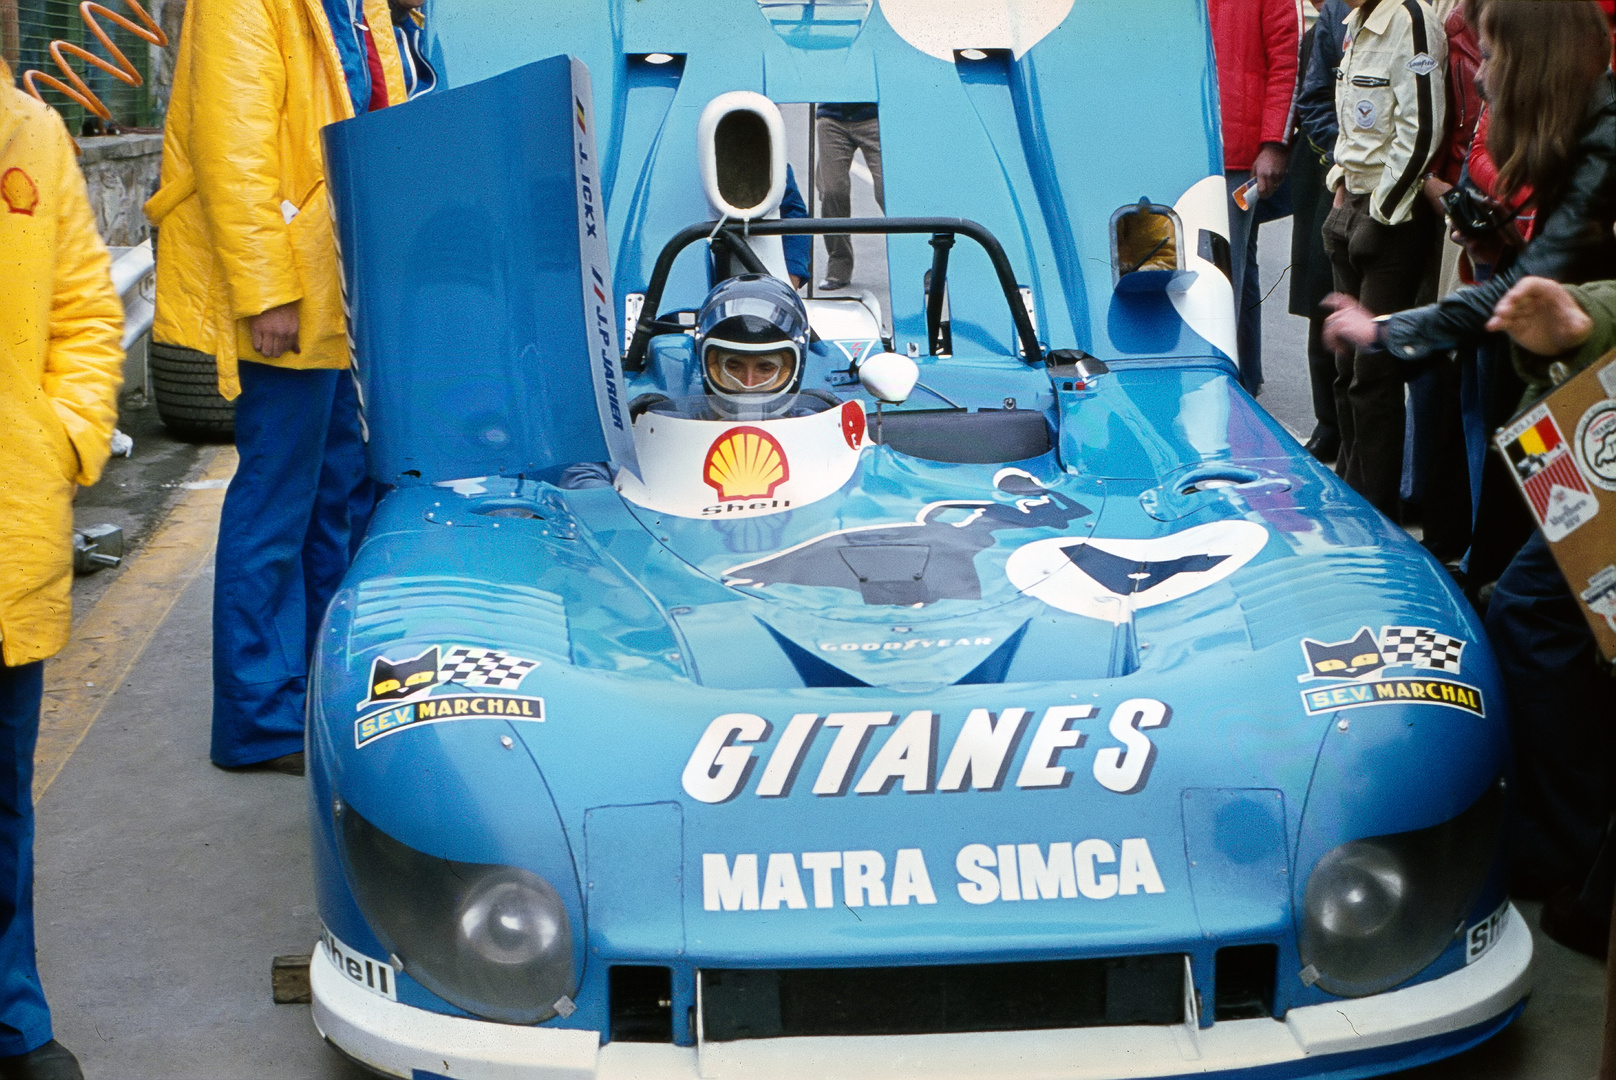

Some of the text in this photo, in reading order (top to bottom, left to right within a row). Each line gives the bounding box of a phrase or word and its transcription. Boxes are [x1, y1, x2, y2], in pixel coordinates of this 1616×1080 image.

[579, 142, 597, 239] J. ICKX
[601, 348, 624, 431] JARIER
[701, 500, 790, 515] Shell
[819, 637, 992, 651] GOODYEAR
[361, 698, 534, 737] S.E.V. MARCHAL
[1311, 682, 1478, 709] S.E.V. MARCHAL
[681, 698, 1172, 803] GITANES
[702, 837, 1166, 912] MATRA SIMCA
